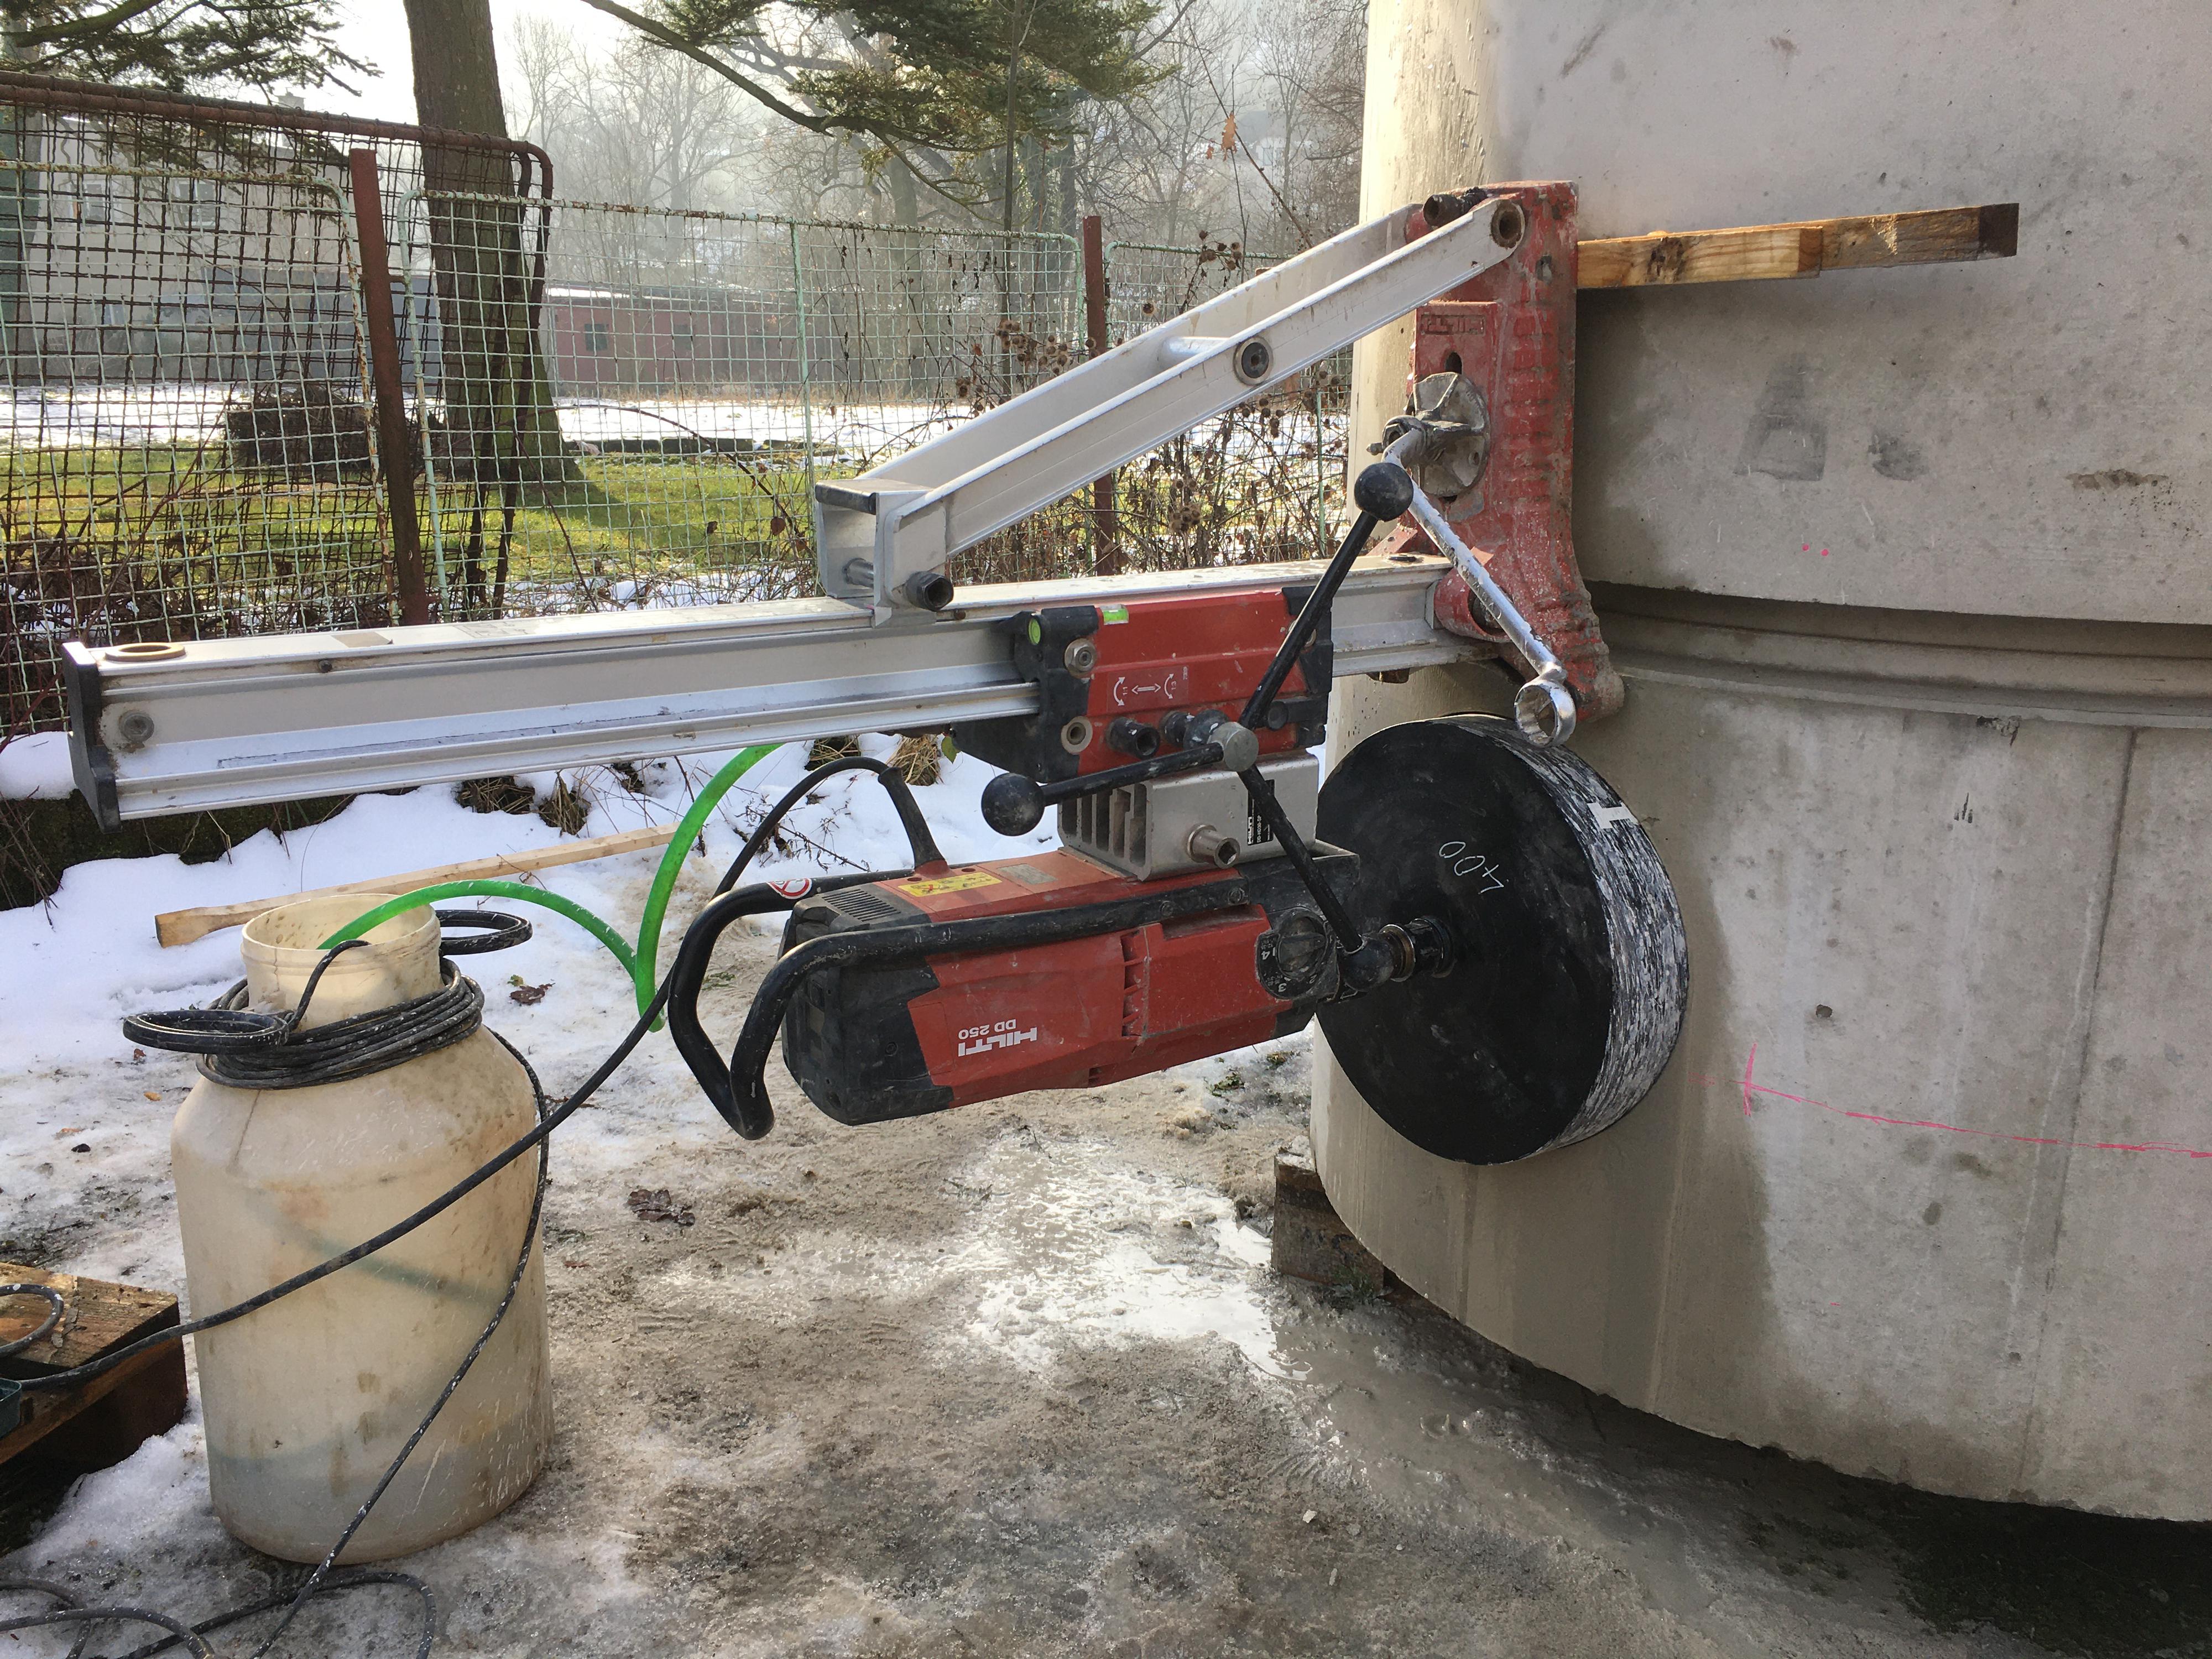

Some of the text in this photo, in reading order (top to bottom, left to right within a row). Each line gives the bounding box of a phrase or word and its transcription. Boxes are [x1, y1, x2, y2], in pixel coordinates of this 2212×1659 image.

[1261, 951, 1270, 961] 4
[1278, 983, 1287, 993] 3
[958, 1019, 1016, 1040] DD 250
[958, 1027, 1037, 1057] HILTI
